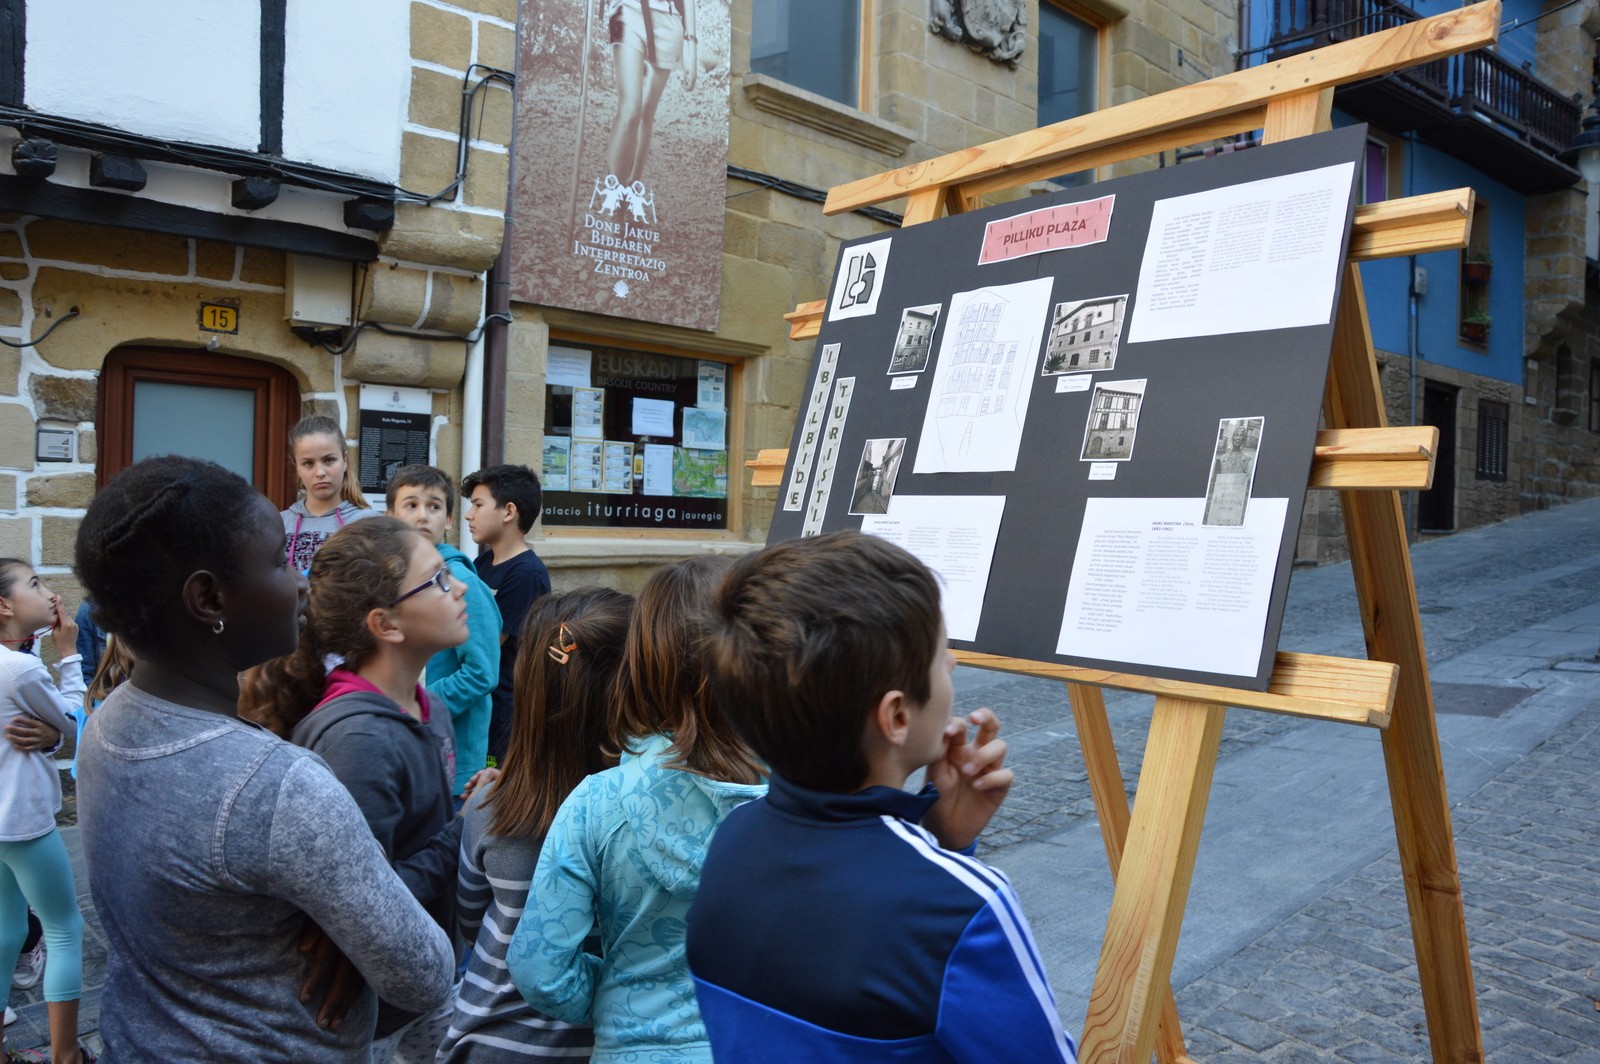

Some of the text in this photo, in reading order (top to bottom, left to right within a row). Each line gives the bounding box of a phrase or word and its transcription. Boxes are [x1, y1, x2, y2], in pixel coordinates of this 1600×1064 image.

[1003, 219, 1087, 245] PILLIKU PLAZA
[210, 309, 229, 328] 15
[598, 355, 677, 380] EUSKADI
[597, 376, 678, 393] BASQUE COUNTRY
[790, 350, 834, 506] IBILBIDE
[587, 501, 676, 522] iturriaga
[681, 510, 722, 521] jauregia
